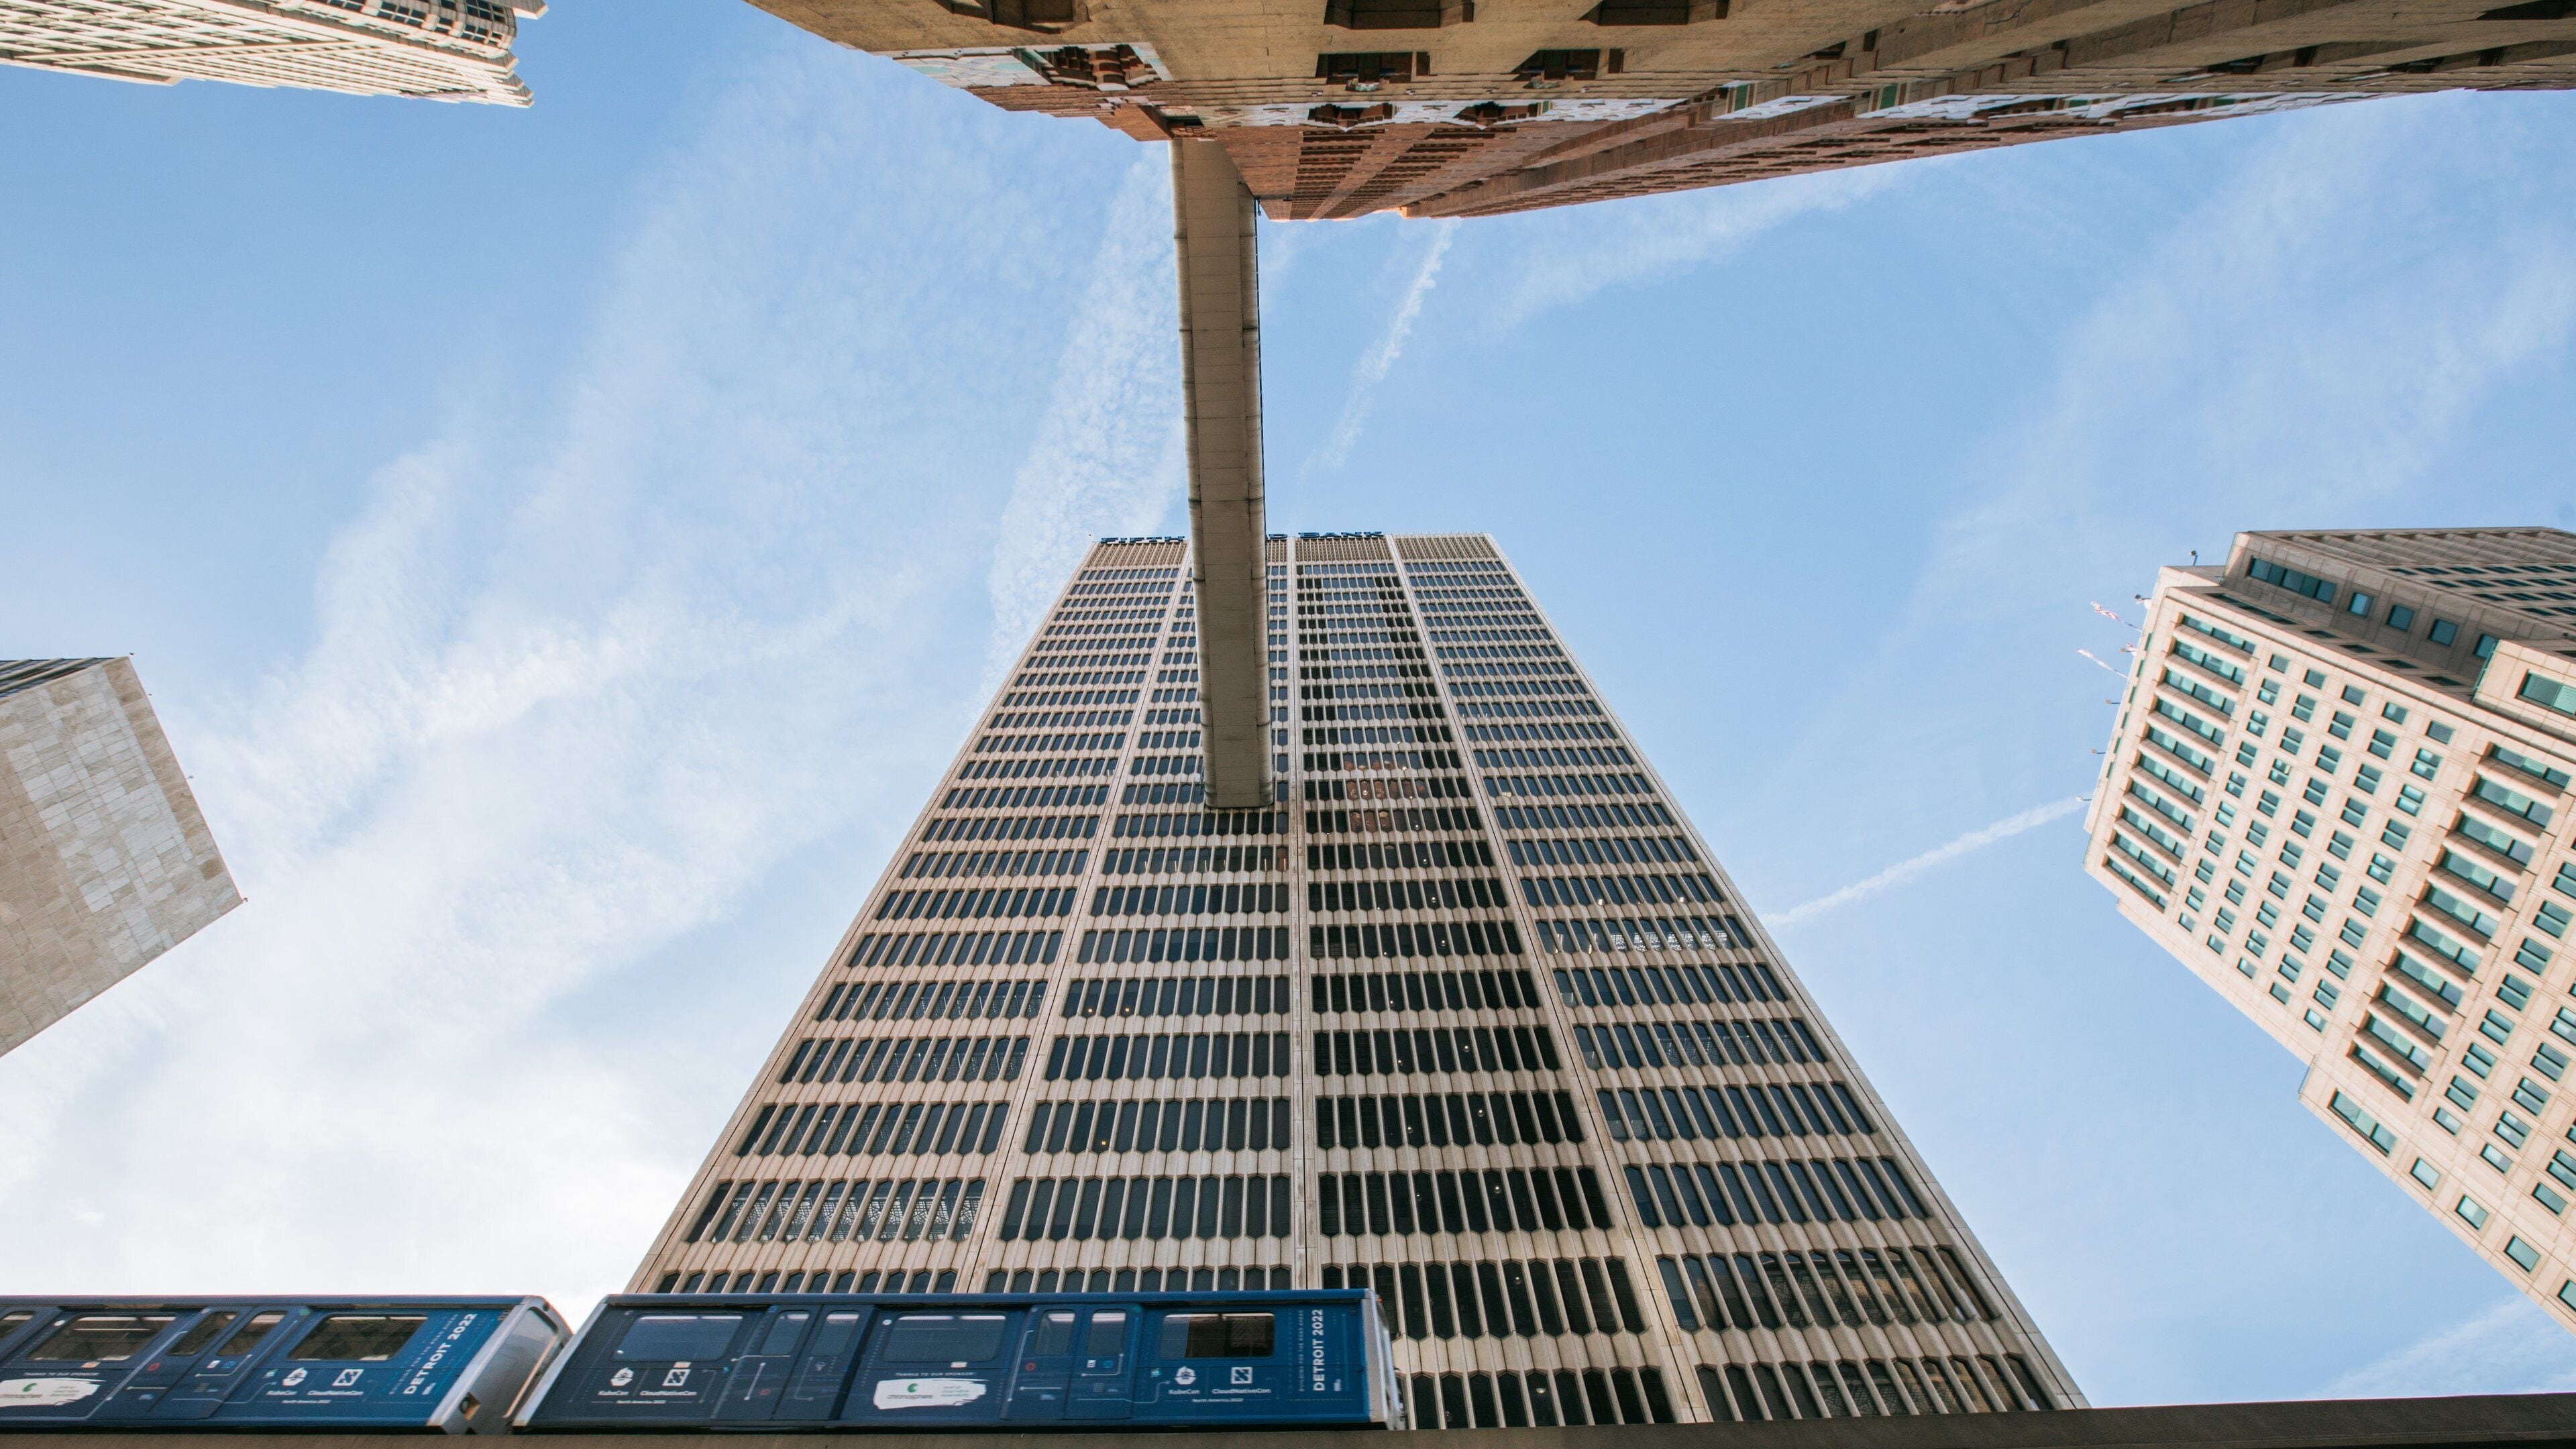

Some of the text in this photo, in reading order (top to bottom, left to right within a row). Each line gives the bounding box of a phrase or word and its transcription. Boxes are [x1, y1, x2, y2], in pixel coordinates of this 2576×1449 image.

[1101, 531, 1384, 544] FIFTH BANK
[402, 1313, 478, 1395] DETROIT 2022
[1311, 1309, 1326, 1391] DETROIT 2022
